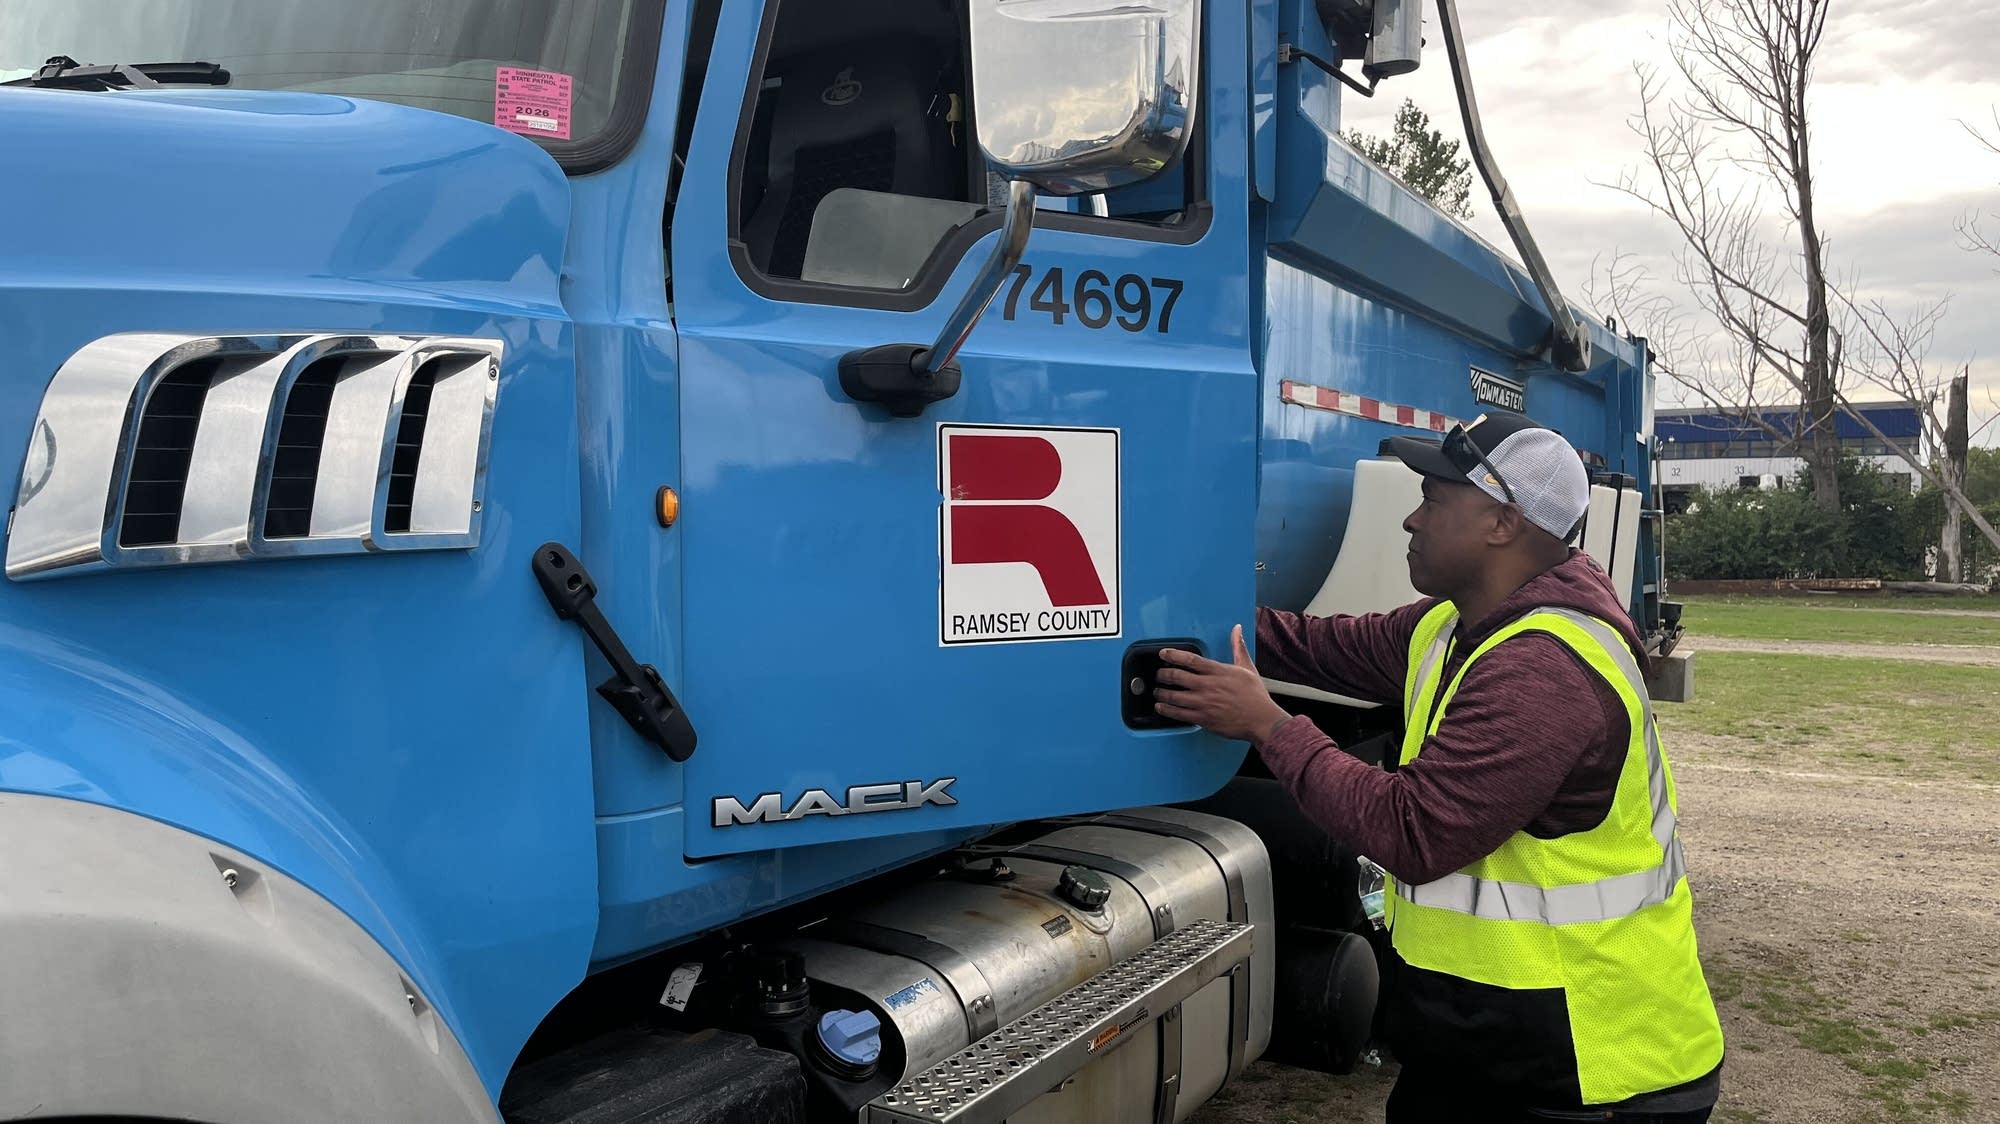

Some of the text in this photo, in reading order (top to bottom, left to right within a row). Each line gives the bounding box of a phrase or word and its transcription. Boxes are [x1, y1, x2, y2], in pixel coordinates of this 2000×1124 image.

[516, 70, 554, 80] MINNESOTA
[532, 78, 557, 86] PATROL
[515, 106, 550, 117] 2026
[1002, 263, 1184, 334] 74697
[1474, 371, 1524, 411] TOWMASTER
[1671, 467, 1681, 477] 32
[1734, 465, 1745, 475] 33
[952, 609, 1111, 635] RAMSEY COUNTY
[712, 777, 958, 828] MACK
